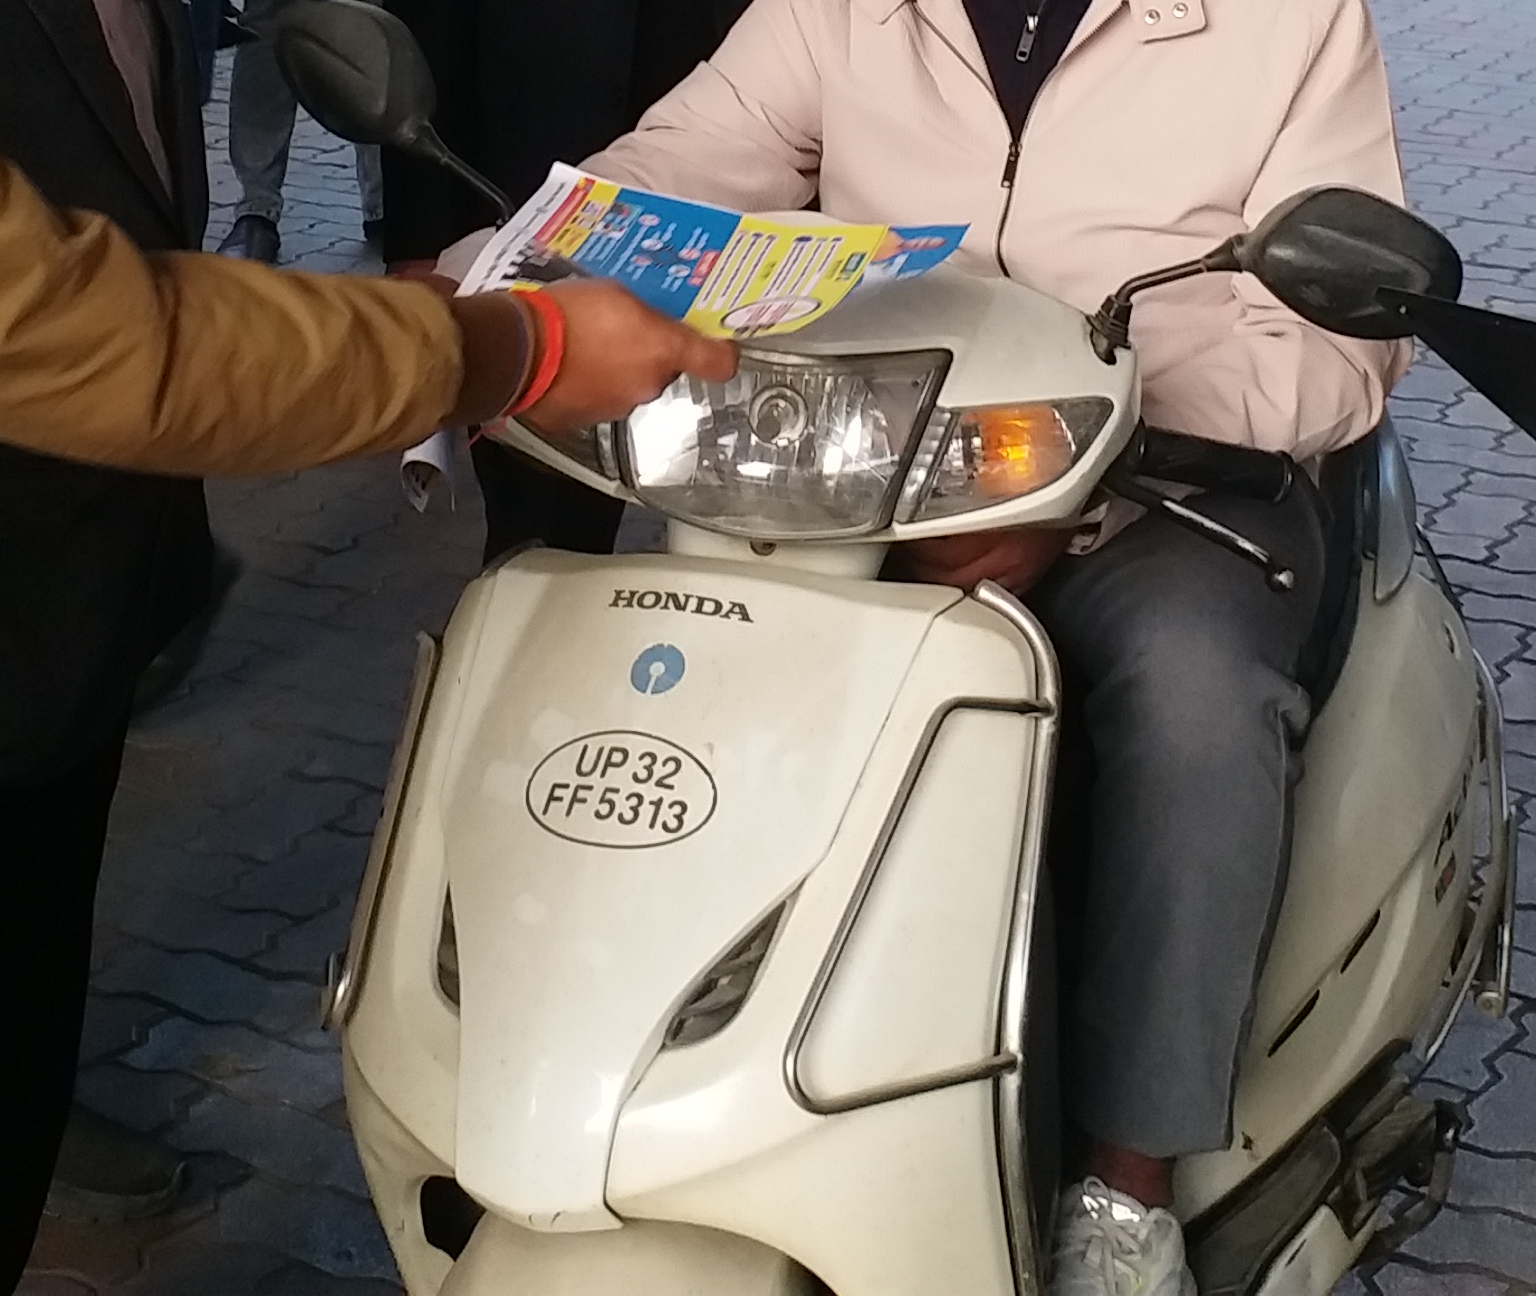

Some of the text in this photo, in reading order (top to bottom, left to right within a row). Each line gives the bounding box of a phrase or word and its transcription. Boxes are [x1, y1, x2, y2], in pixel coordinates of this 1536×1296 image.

[608, 589, 754, 623] HONDA
[575, 743, 683, 790] UP 32
[542, 782, 688, 834] FF 5313
